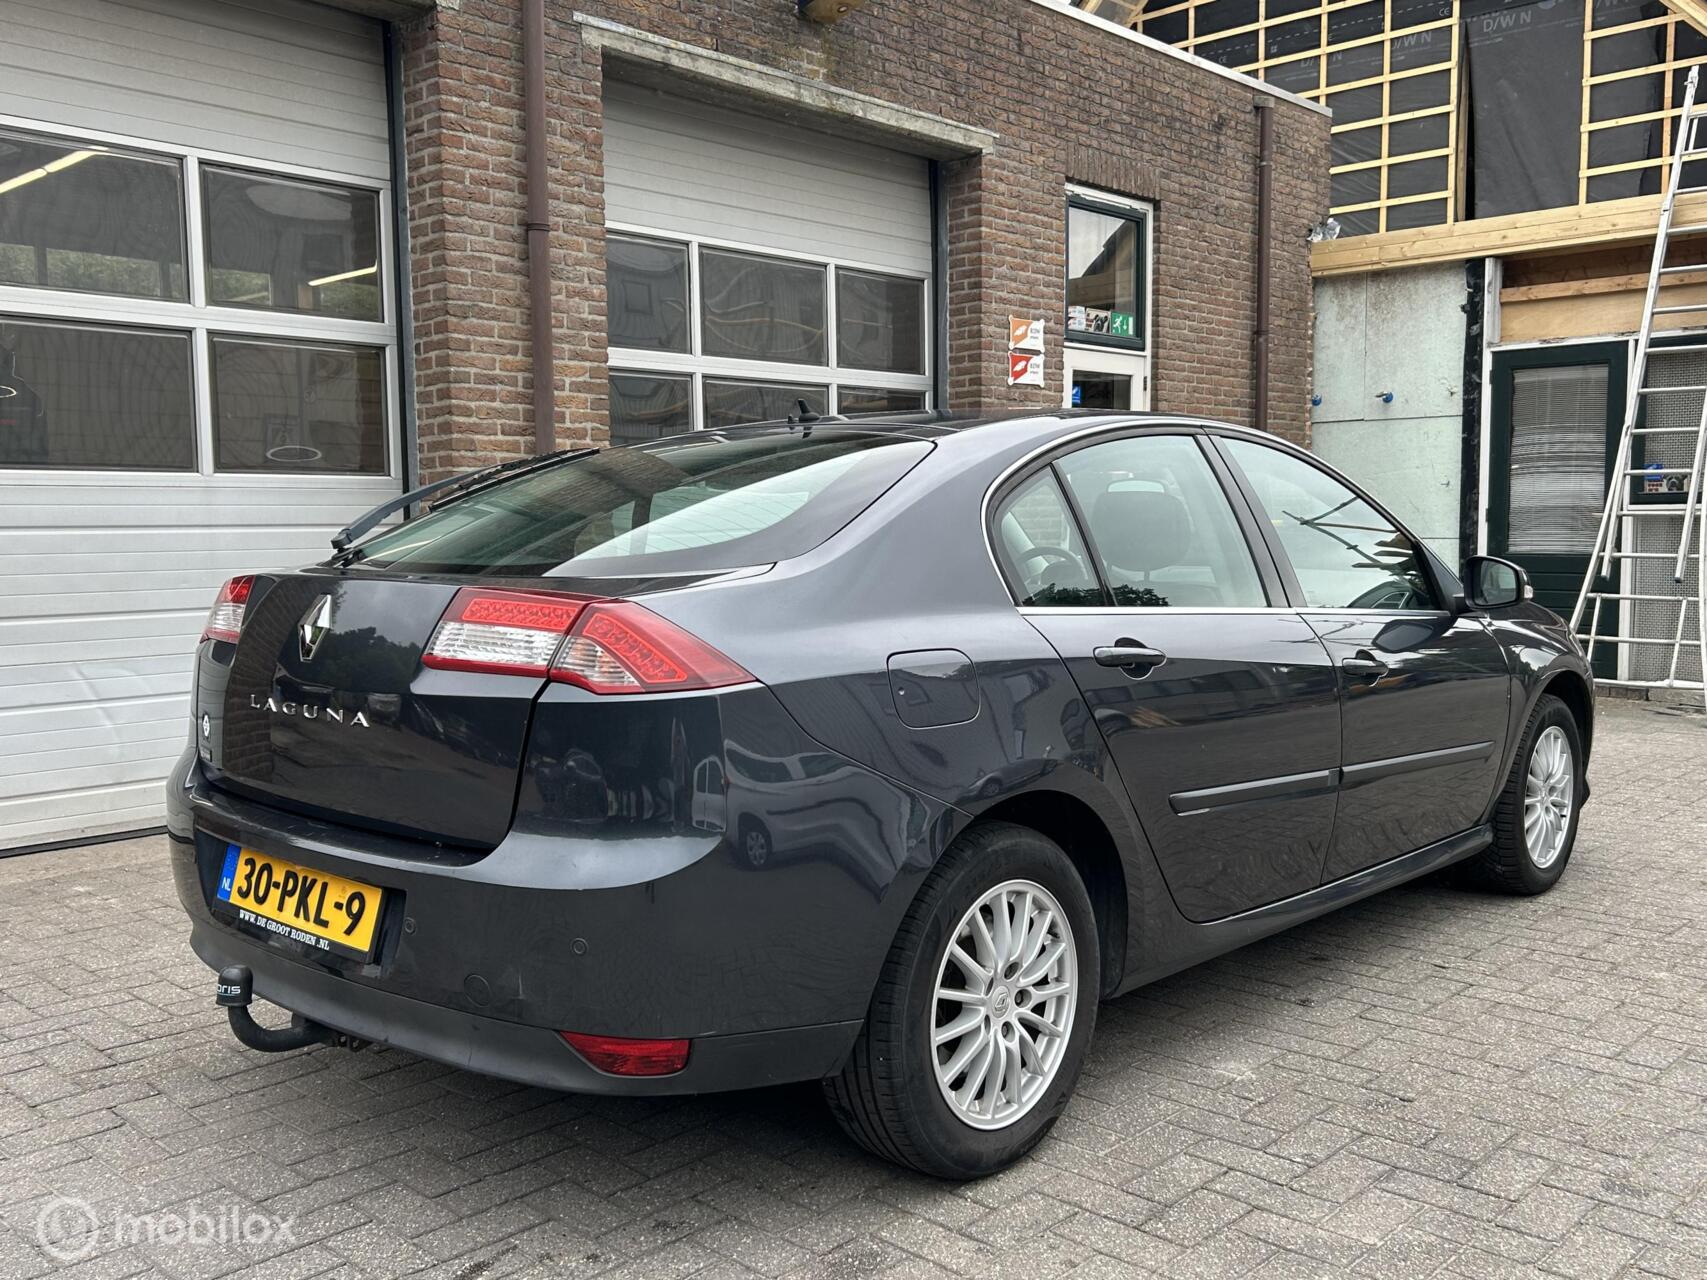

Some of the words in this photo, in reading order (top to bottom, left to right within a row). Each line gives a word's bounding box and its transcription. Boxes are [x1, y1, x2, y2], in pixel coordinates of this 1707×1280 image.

[250, 694, 370, 728] LAGUNA
[221, 876, 231, 891] NL
[236, 857, 366, 937] 30-PKL-9
[256, 916, 266, 928] DE
[266, 920, 290, 937] GROOT
[290, 928, 317, 946] RODEN
